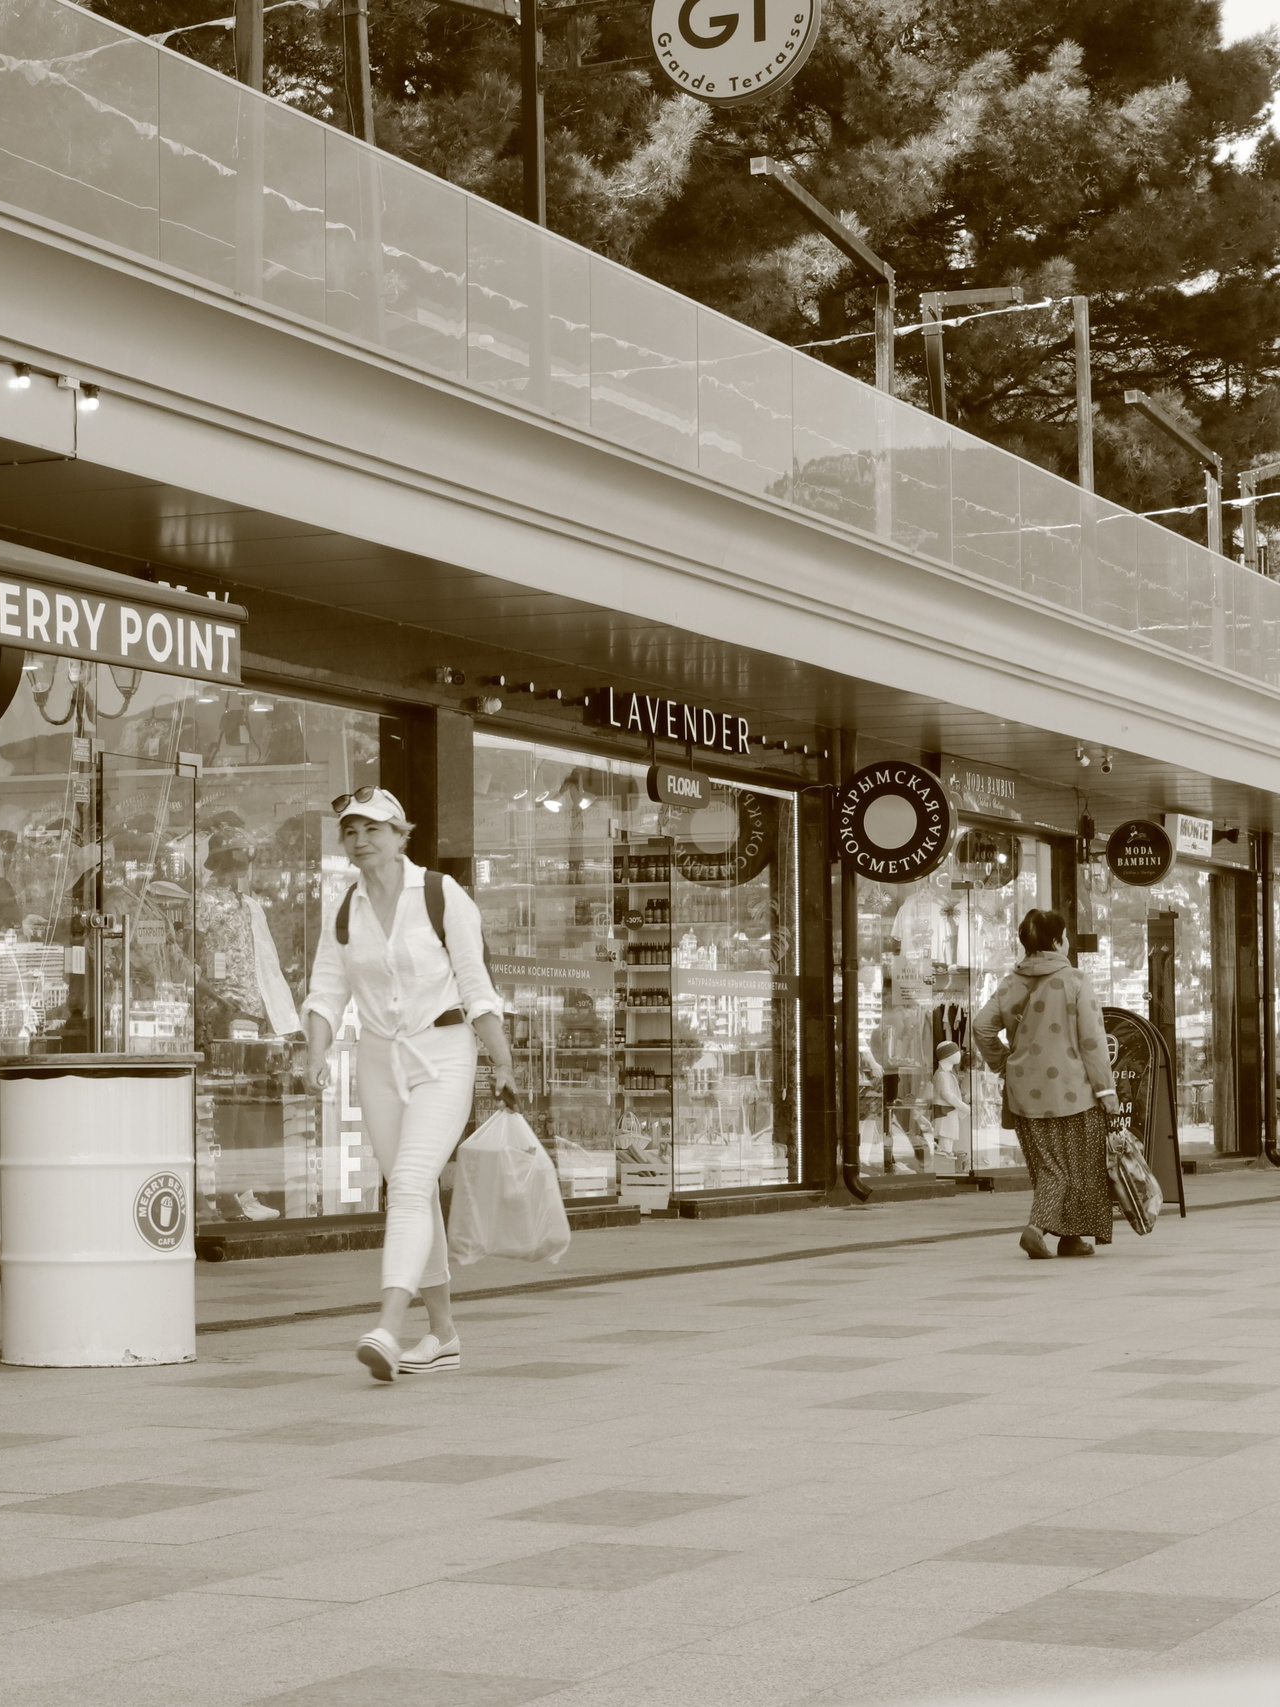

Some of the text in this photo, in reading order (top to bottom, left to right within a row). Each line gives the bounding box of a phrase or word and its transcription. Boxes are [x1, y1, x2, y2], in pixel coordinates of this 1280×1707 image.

[657, 13, 805, 93] Grande Terrasse
[120, 605, 237, 674] POINT
[609, 686, 751, 755] LAVENDER
[666, 774, 703, 800] FLORAL
[841, 769, 939, 816] КРЫМСКАЯ
[965, 771, 1015, 800] MODA BAMBINI
[1180, 818, 1209, 841] MONTE
[840, 825, 942, 874] КОСМЕТИКА
[1117, 857, 1161, 867] BAMBINI
[1125, 846, 1153, 855] MODA
[138, 927, 164, 937] ОТКРЫТО
[489, 963, 591, 979] НИЧЕСКАЯ КОСМЕТИКА КРЫМА
[687, 977, 788, 991] НАТУРАЛЬНАЯ КРЫМСКАЯ КОСМЕТИКА
[336, 994, 362, 1204] ALE
[138, 1176, 186, 1217] MERRY BERRY
[157, 1238, 175, 1246] CAFE
